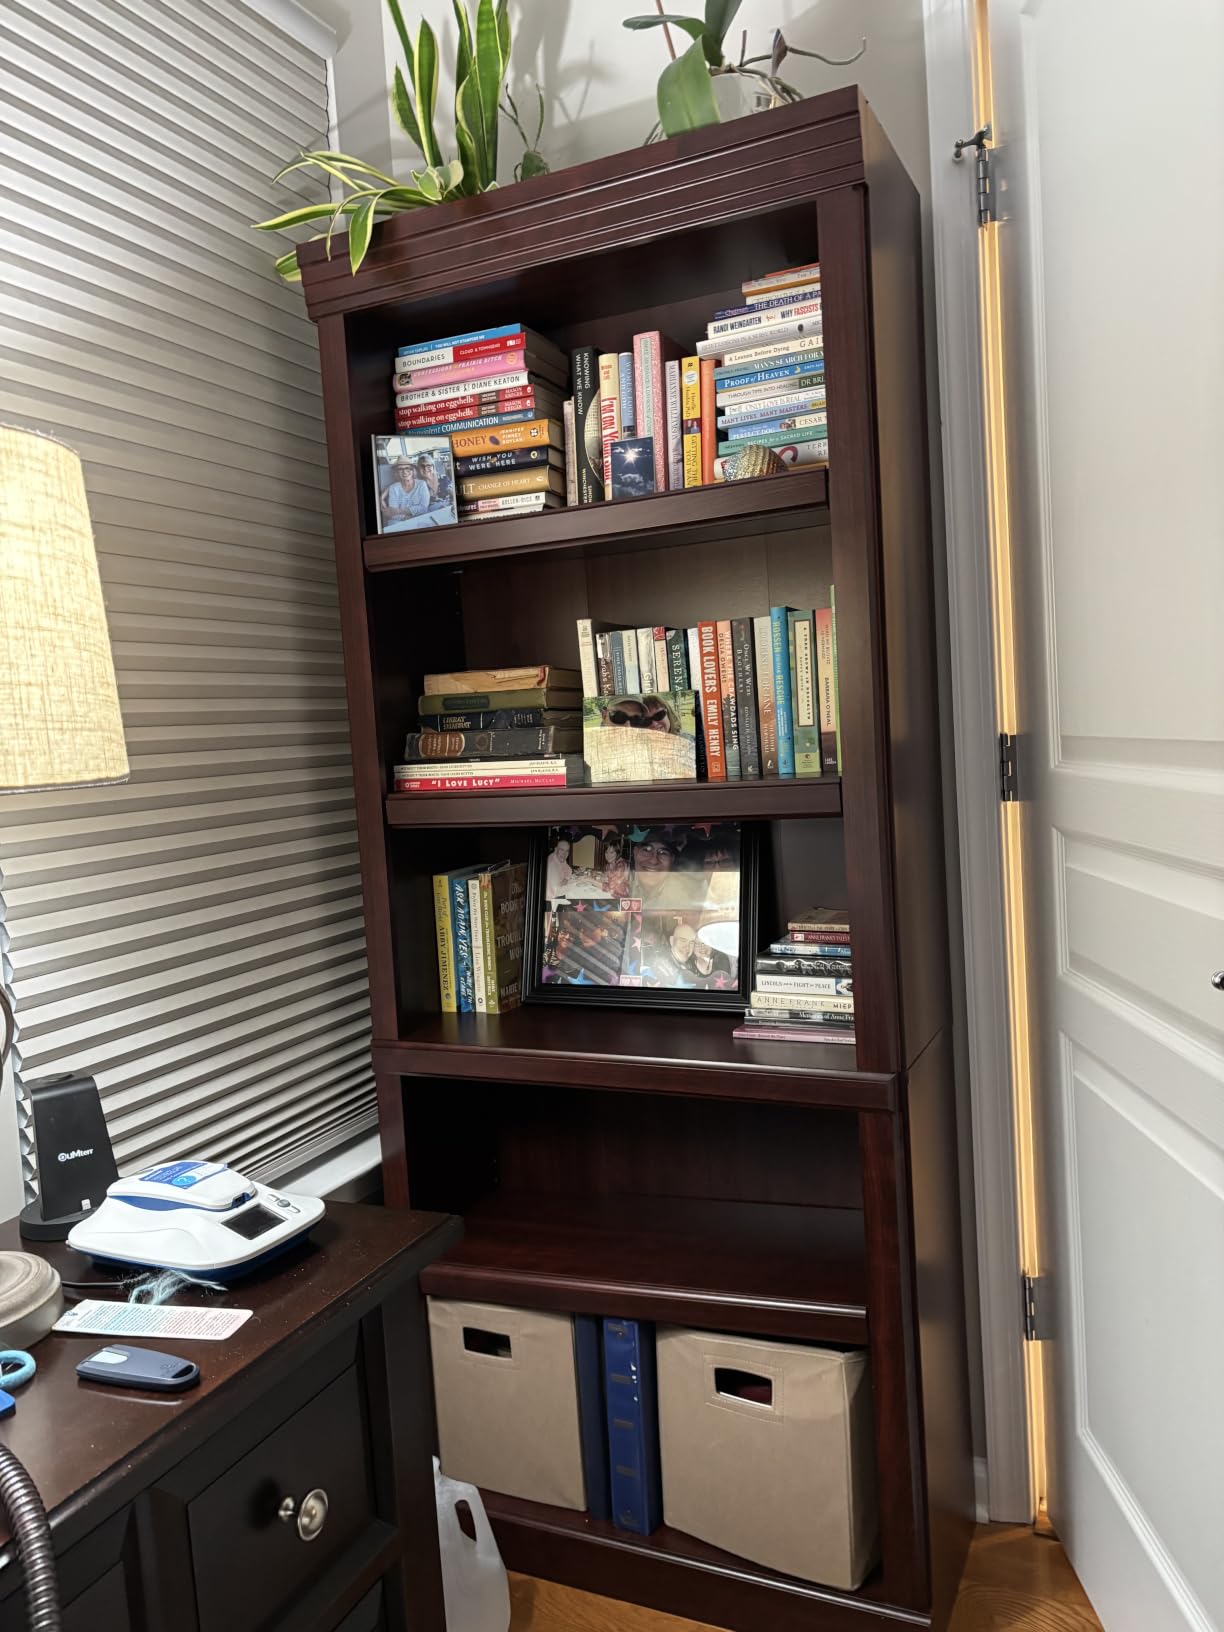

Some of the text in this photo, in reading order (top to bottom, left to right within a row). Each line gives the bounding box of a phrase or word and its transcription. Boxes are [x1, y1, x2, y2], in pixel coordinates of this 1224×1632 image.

[754, 301, 767, 311] THE
[769, 296, 793, 307] DEATH
[793, 293, 803, 302] OF
[780, 309, 793, 319] WHY
[793, 304, 819, 316] FASCISTS
[713, 324, 729, 334] RANDI
[730, 316, 762, 331] WEINGARTEN
[754, 349, 772, 358] Before
[773, 345, 790, 354] Dying
[775, 354, 804, 365] SEARCH
[402, 353, 446, 368] BOUNDARIES
[471, 375, 520, 390] DIANE KEATON
[576, 376, 582, 390] WE
[668, 364, 677, 401] MARIANNE
[724, 376, 752, 388] PROOF
[757, 368, 790, 381] HEAVEN
[801, 378, 811, 386] DR
[401, 391, 429, 402] BROTHER
[437, 385, 460, 396] SISTER
[399, 405, 412, 417] stop
[412, 402, 436, 414] walking
[445, 396, 474, 408] eggshells
[601, 396, 617, 415] I'M
[721, 403, 808, 425] MANY MANY MASTERS
[399, 419, 411, 428] stop
[412, 414, 435, 426] walking
[445, 409, 473, 420] eggshells
[441, 417, 499, 432] COMMUNICATION
[602, 416, 616, 431] ON
[799, 415, 823, 426] CESAR
[500, 427, 524, 435] JENNIFER
[780, 432, 801, 441] SACRED
[502, 437, 523, 445] BOYLAN
[468, 463, 491, 471] WERE
[495, 459, 516, 467] HERE
[471, 455, 492, 463] WISH
[772, 621, 781, 653] ROSSEN
[671, 644, 683, 692] SERENA
[736, 649, 744, 693] BROTHERS
[724, 630, 732, 661] WHERE
[728, 683, 736, 728] CRAWDADS
[702, 626, 721, 757] BOOK LOVERS EMILY HENRY
[775, 674, 785, 705] RESCUE
[763, 690, 772, 715] JANE
[446, 779, 467, 787] LOVE
[455, 884, 464, 905] ASK
[459, 938, 468, 958] YES
[439, 926, 449, 991] ABBY JIMENEZ
[756, 997, 825, 1007] ANNE FRANK
